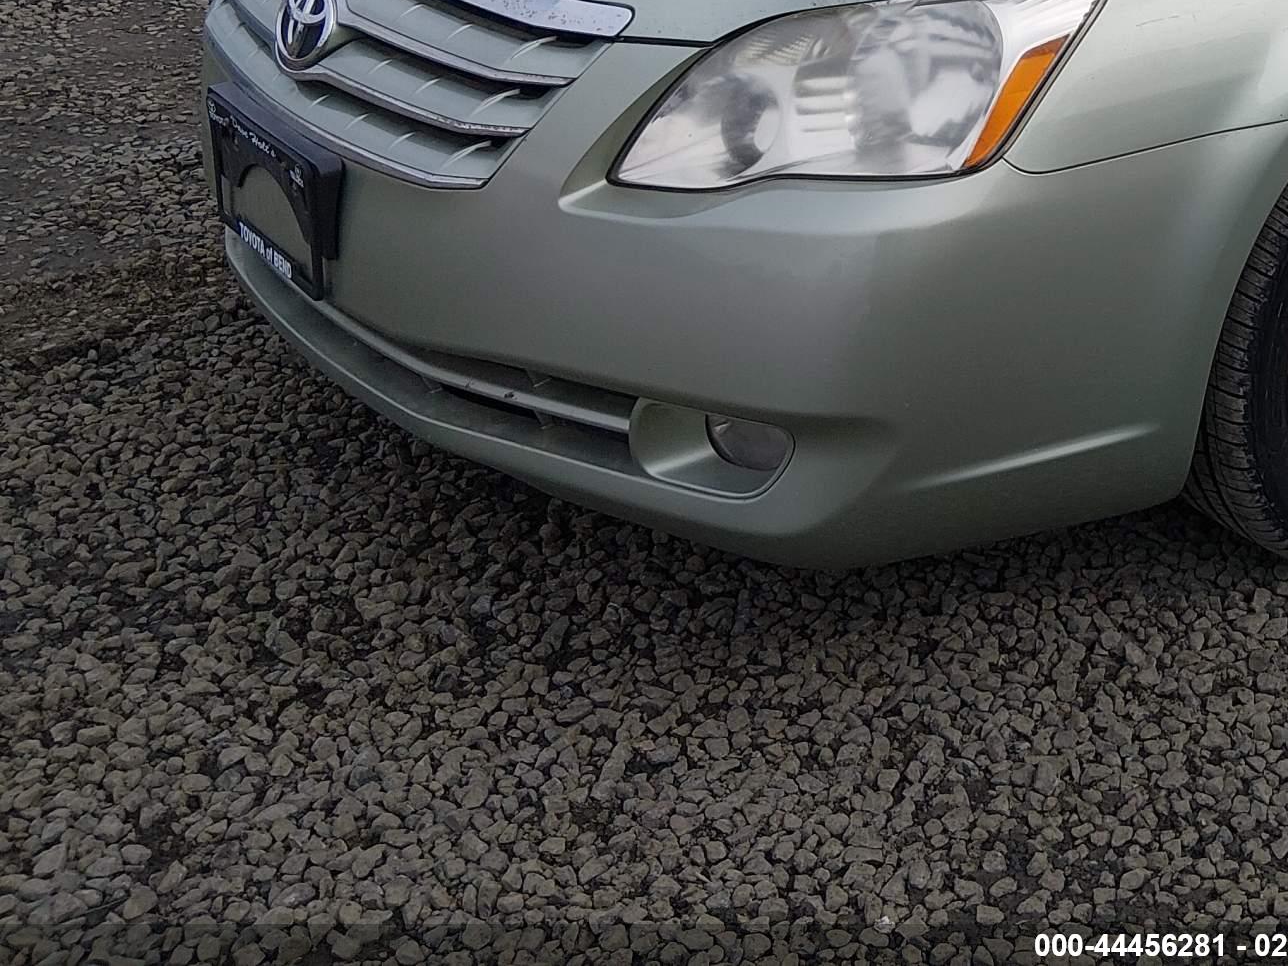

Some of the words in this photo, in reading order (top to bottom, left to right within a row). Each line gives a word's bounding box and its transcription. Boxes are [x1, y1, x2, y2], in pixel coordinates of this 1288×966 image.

[239, 222, 265, 257] TOYOTA
[266, 247, 273, 263] of
[273, 250, 292, 278] BEND
